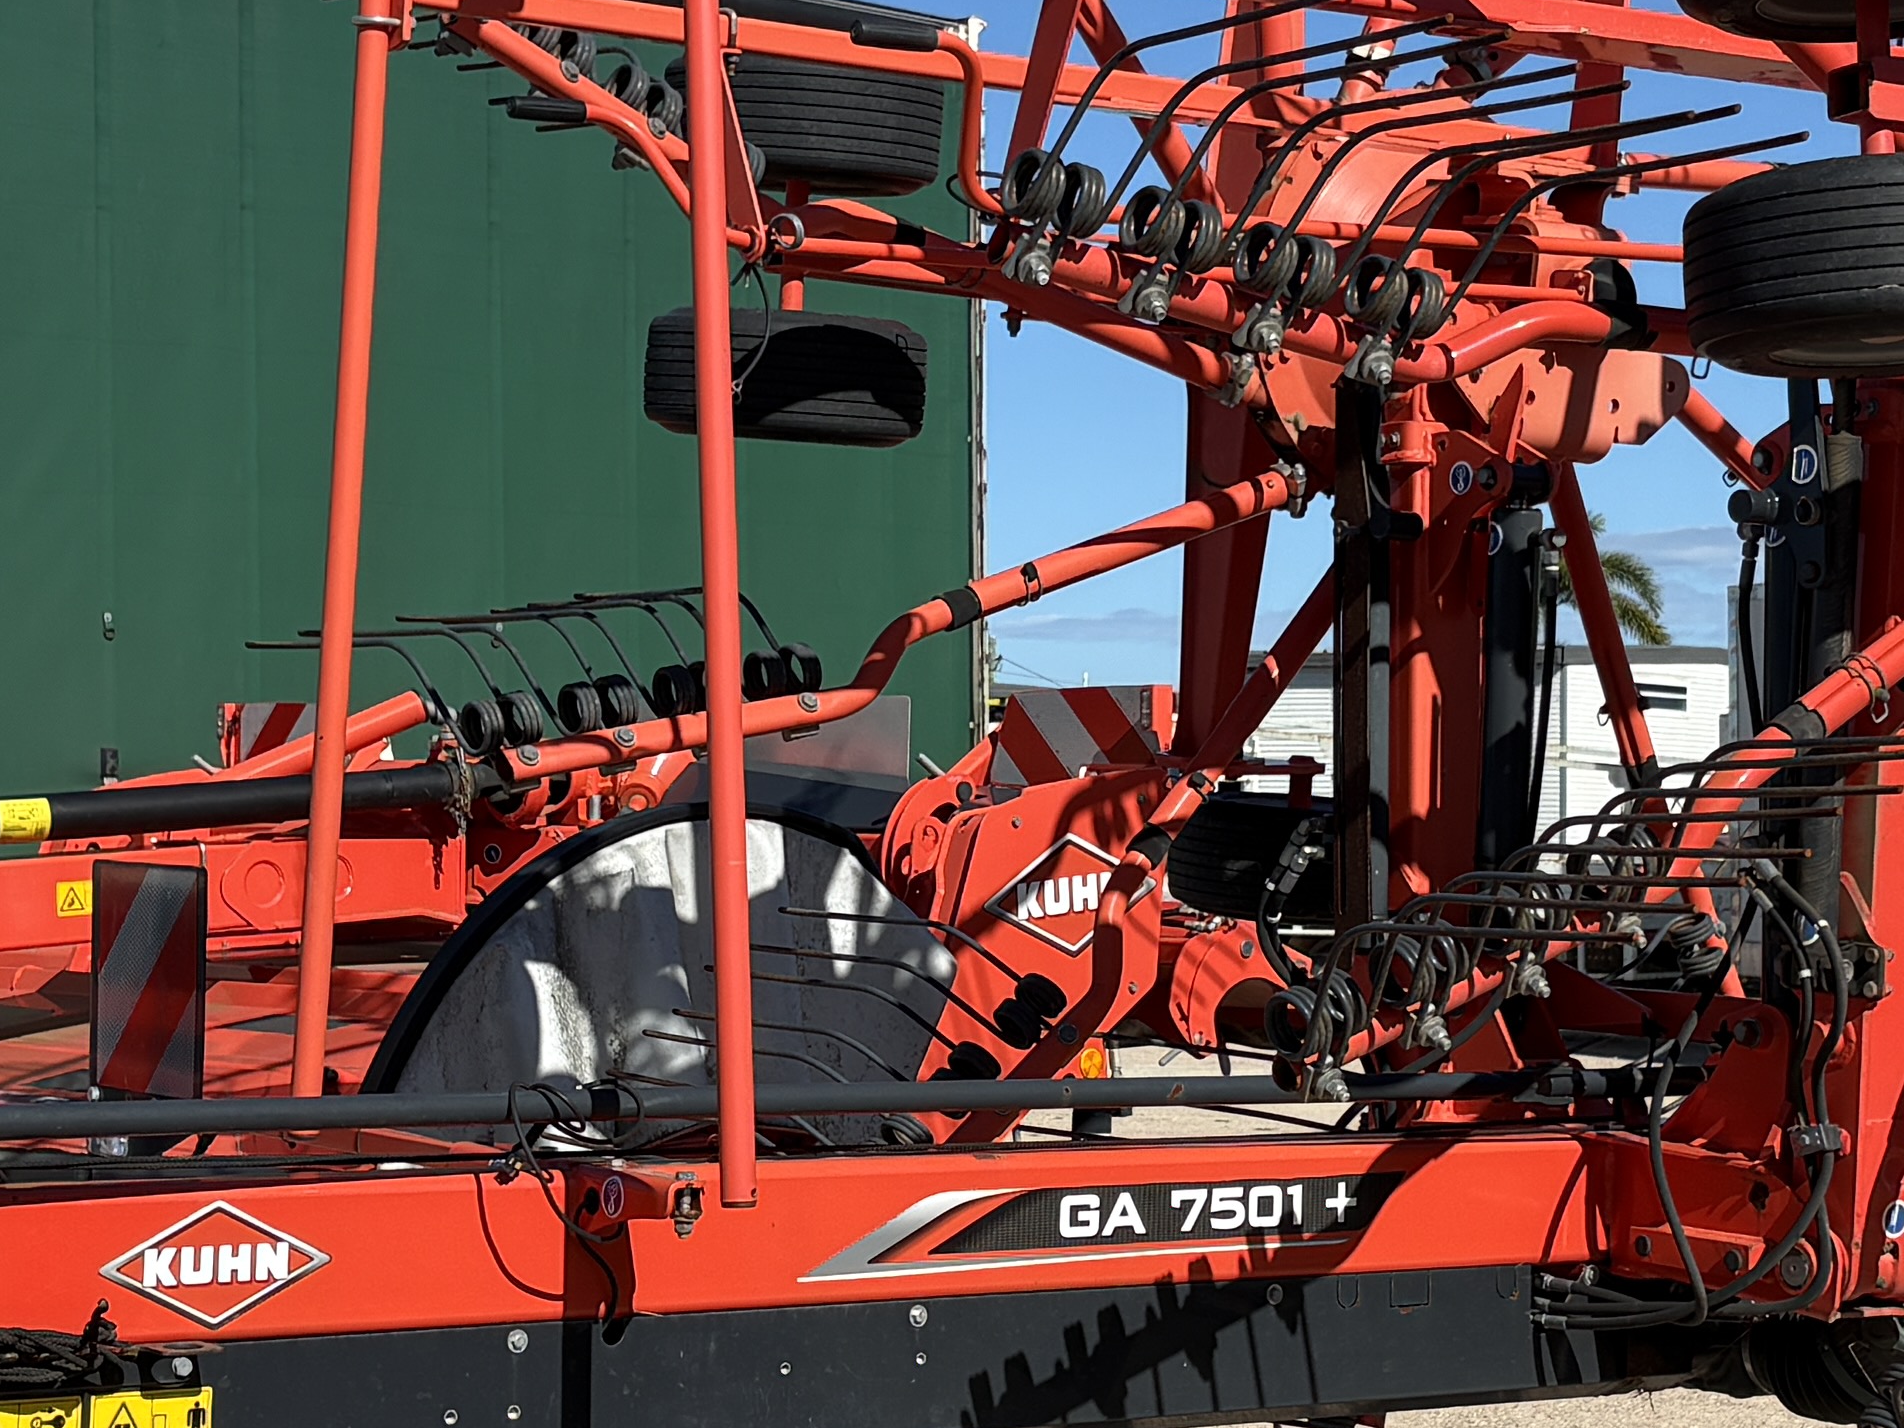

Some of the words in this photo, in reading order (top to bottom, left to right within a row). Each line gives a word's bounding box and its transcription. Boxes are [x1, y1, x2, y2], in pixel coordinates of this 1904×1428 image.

[1016, 871, 1112, 921] KUH
[1058, 1192, 1147, 1239] GA
[1170, 1183, 1303, 1234] 7501
[1324, 1181, 1357, 1223] +
[142, 1241, 290, 1288] KUHN
